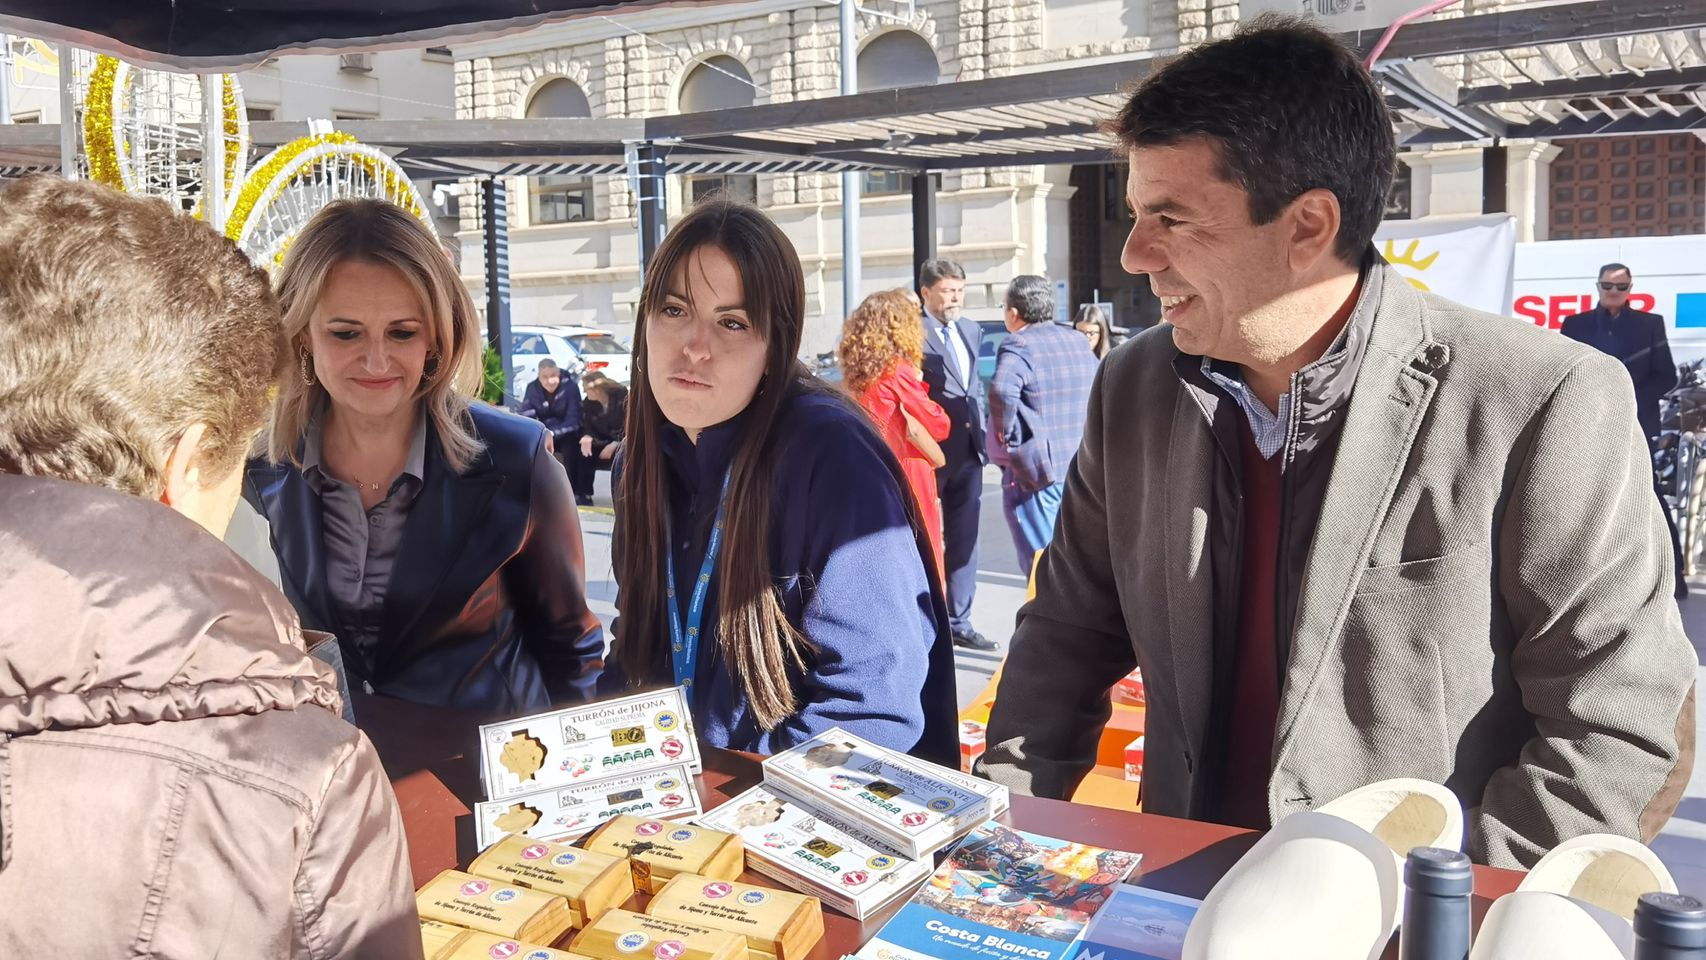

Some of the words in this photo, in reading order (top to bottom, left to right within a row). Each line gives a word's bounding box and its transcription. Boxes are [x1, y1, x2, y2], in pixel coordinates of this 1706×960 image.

[571, 708, 615, 723] TURRÓN
[617, 707, 628, 715] de
[631, 699, 666, 713] JIJONA
[881, 758, 916, 778] TURRÓN
[915, 772, 925, 781] de
[924, 777, 974, 802] ALICANTE
[814, 811, 851, 832] TURRÓN
[851, 827, 861, 837] de
[687, 906, 703, 914] Jijona
[735, 915, 758, 925] Alicante
[698, 901, 719, 910] Consejo
[720, 905, 748, 915] Regulador
[925, 919, 981, 943] Costa
[982, 935, 1052, 960] Blanca
